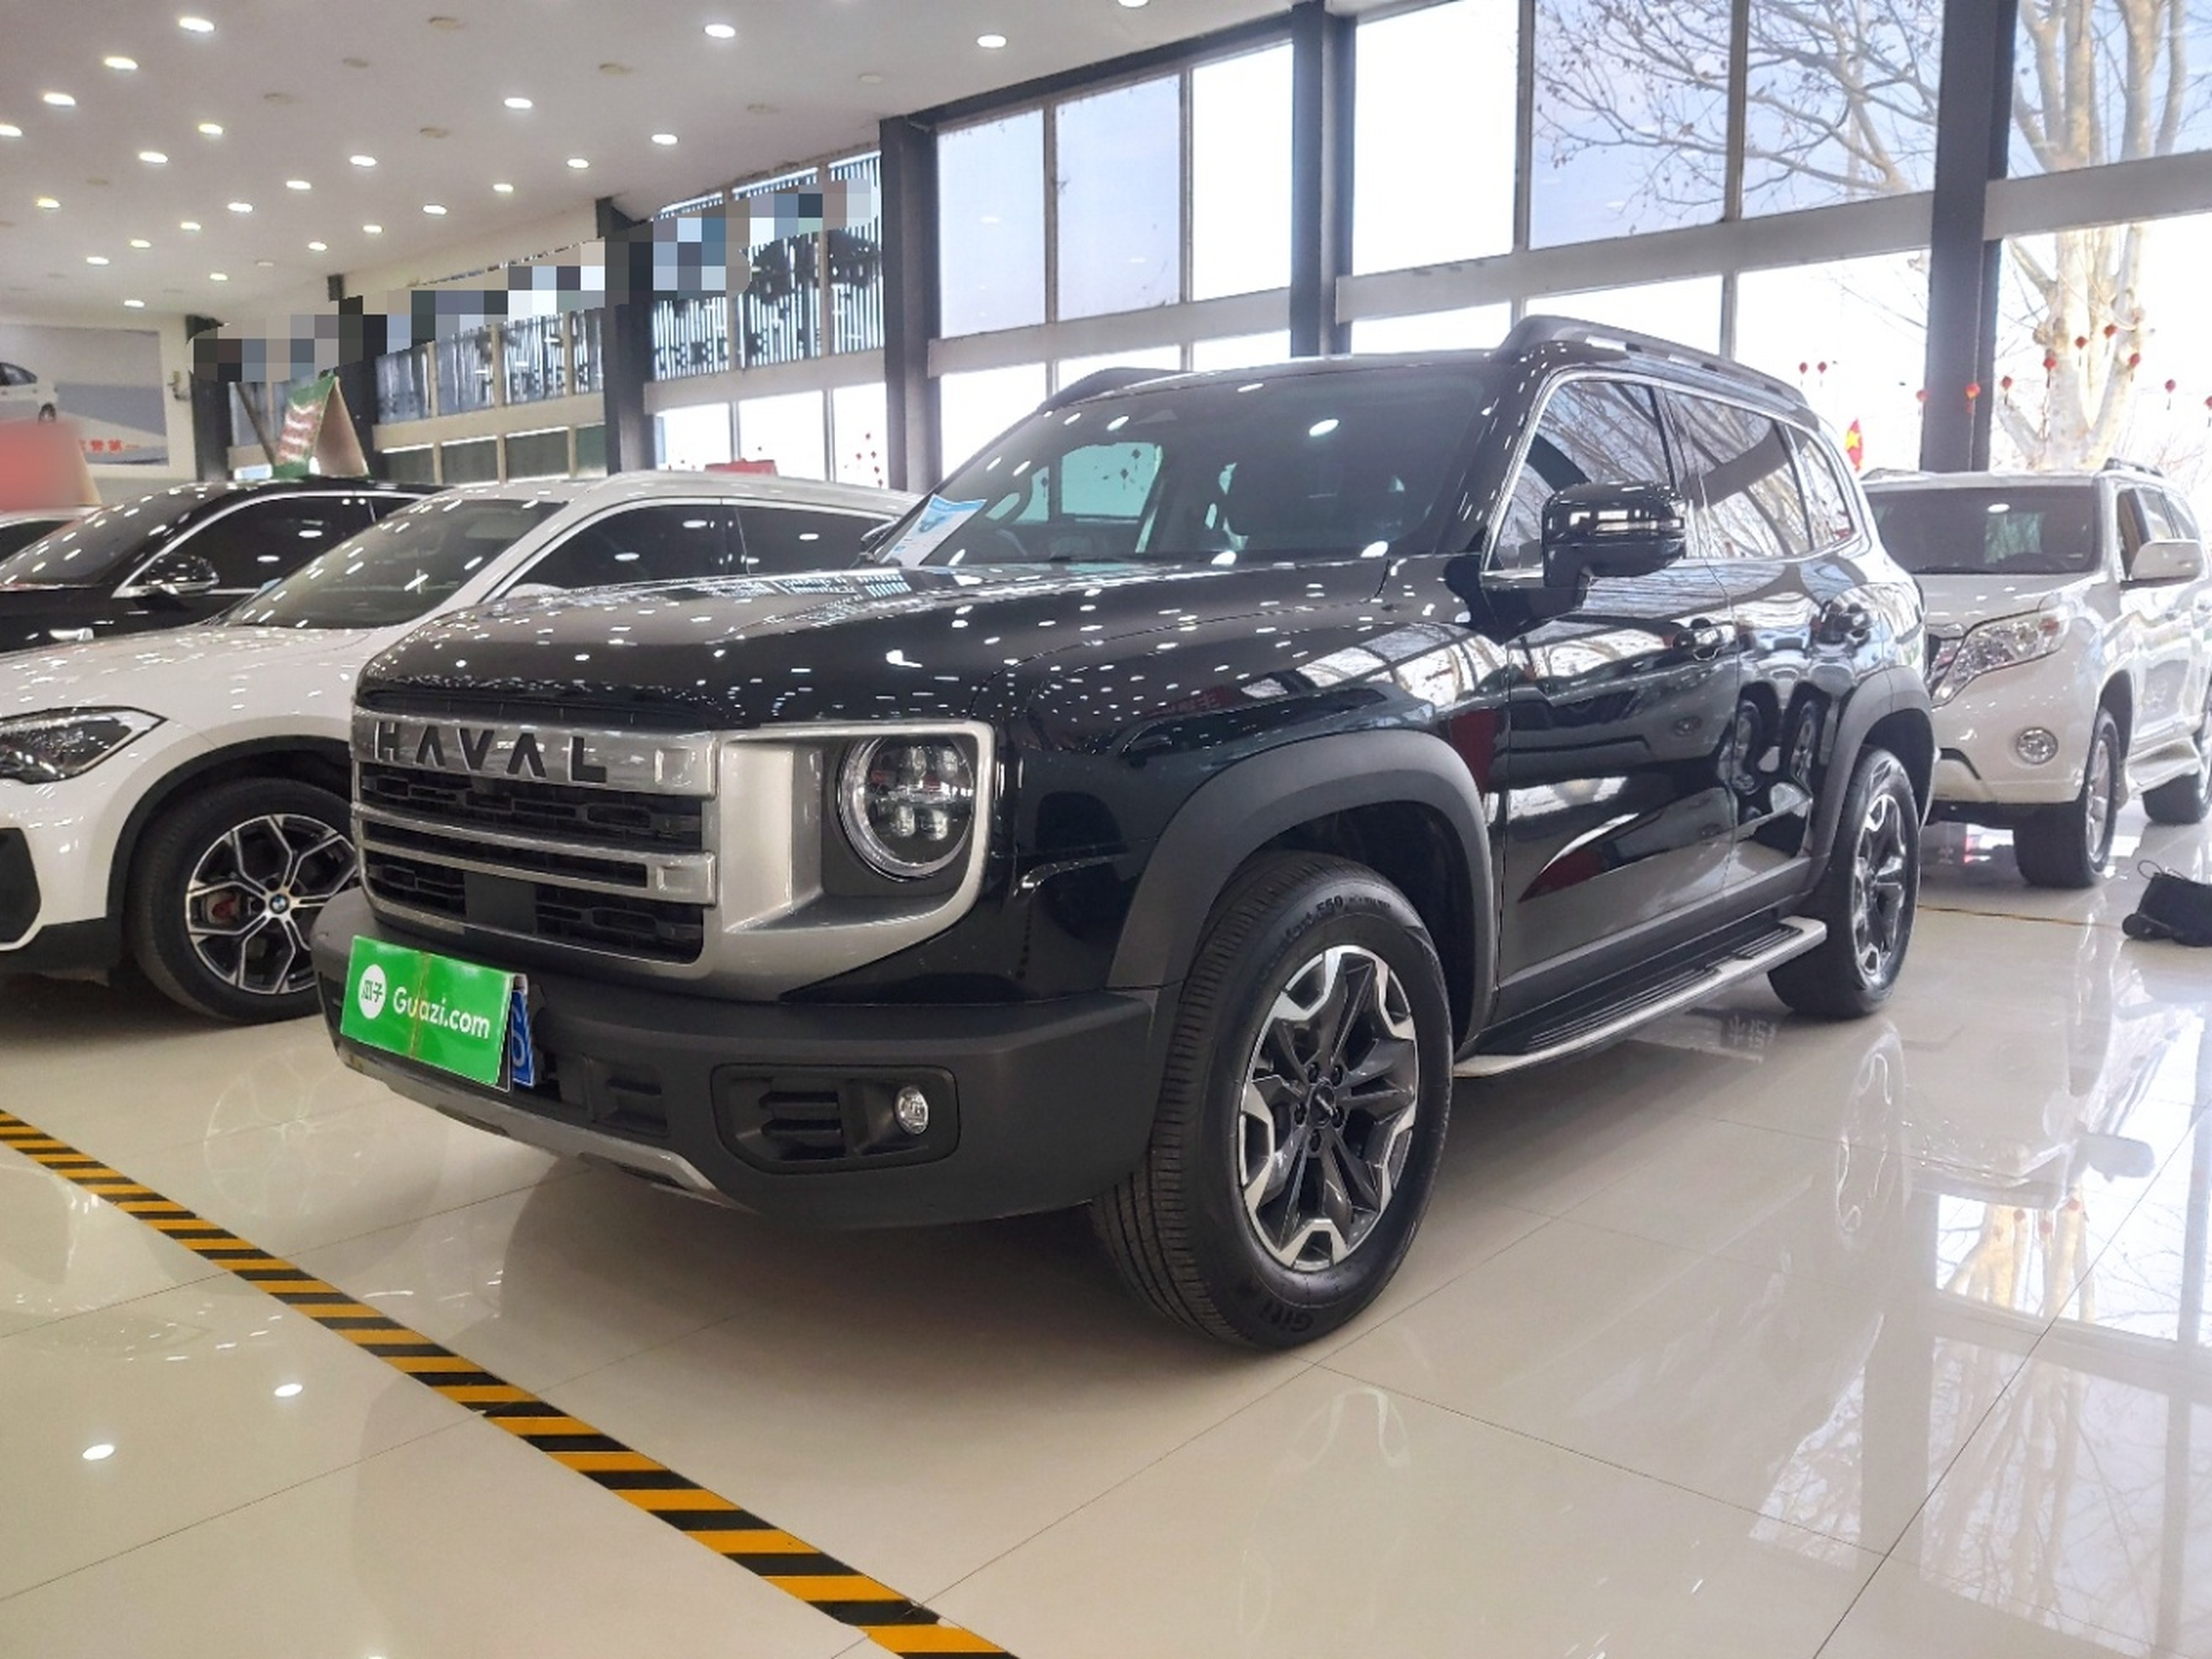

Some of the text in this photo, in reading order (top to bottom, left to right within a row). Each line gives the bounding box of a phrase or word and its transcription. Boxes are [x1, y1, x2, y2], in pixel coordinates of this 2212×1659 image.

[374, 721, 607, 784] HAVAL
[361, 979, 382, 1003] 瓜子
[393, 986, 490, 1039] Guazi.com
